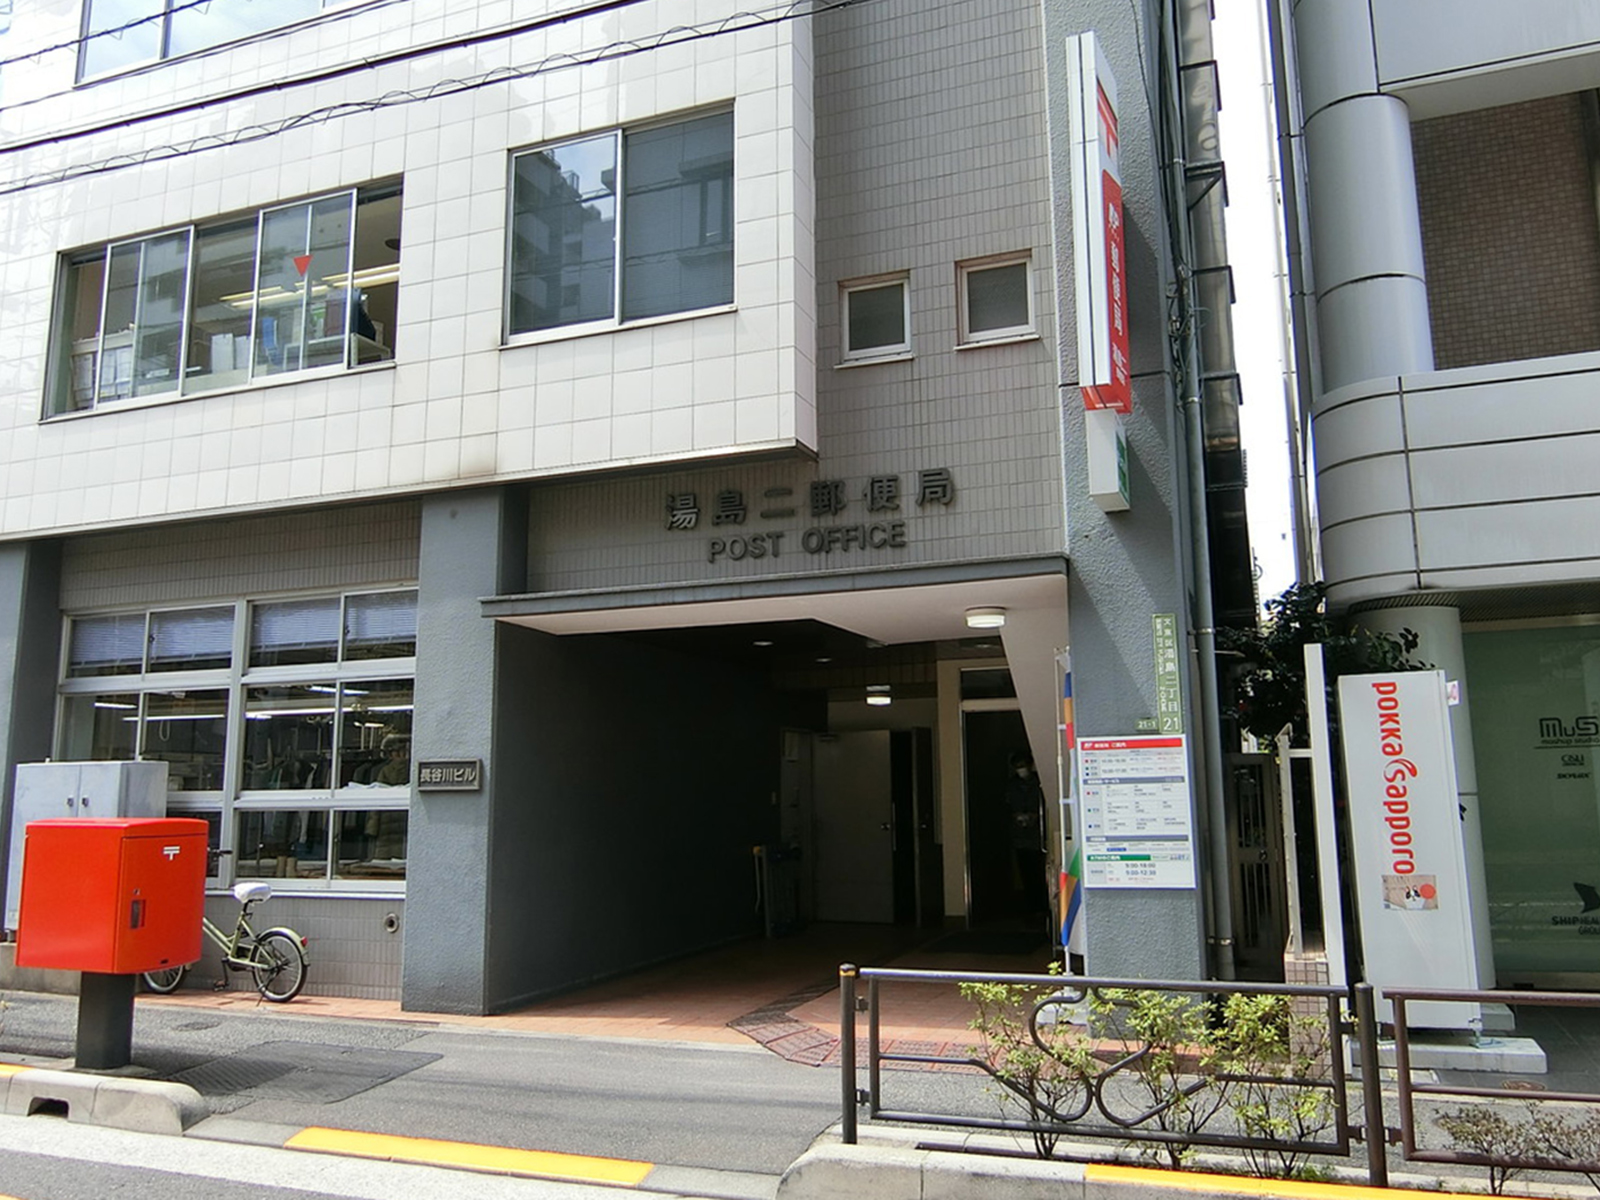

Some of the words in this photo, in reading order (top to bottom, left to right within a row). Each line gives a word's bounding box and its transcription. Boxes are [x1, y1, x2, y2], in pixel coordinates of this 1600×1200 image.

[665, 467, 955, 531] 湯島二郵便局
[708, 531, 786, 563] POST
[802, 521, 907, 555] OFFICE
[1163, 717, 1179, 731] 21
[420, 767, 476, 783] 長谷川ビル
